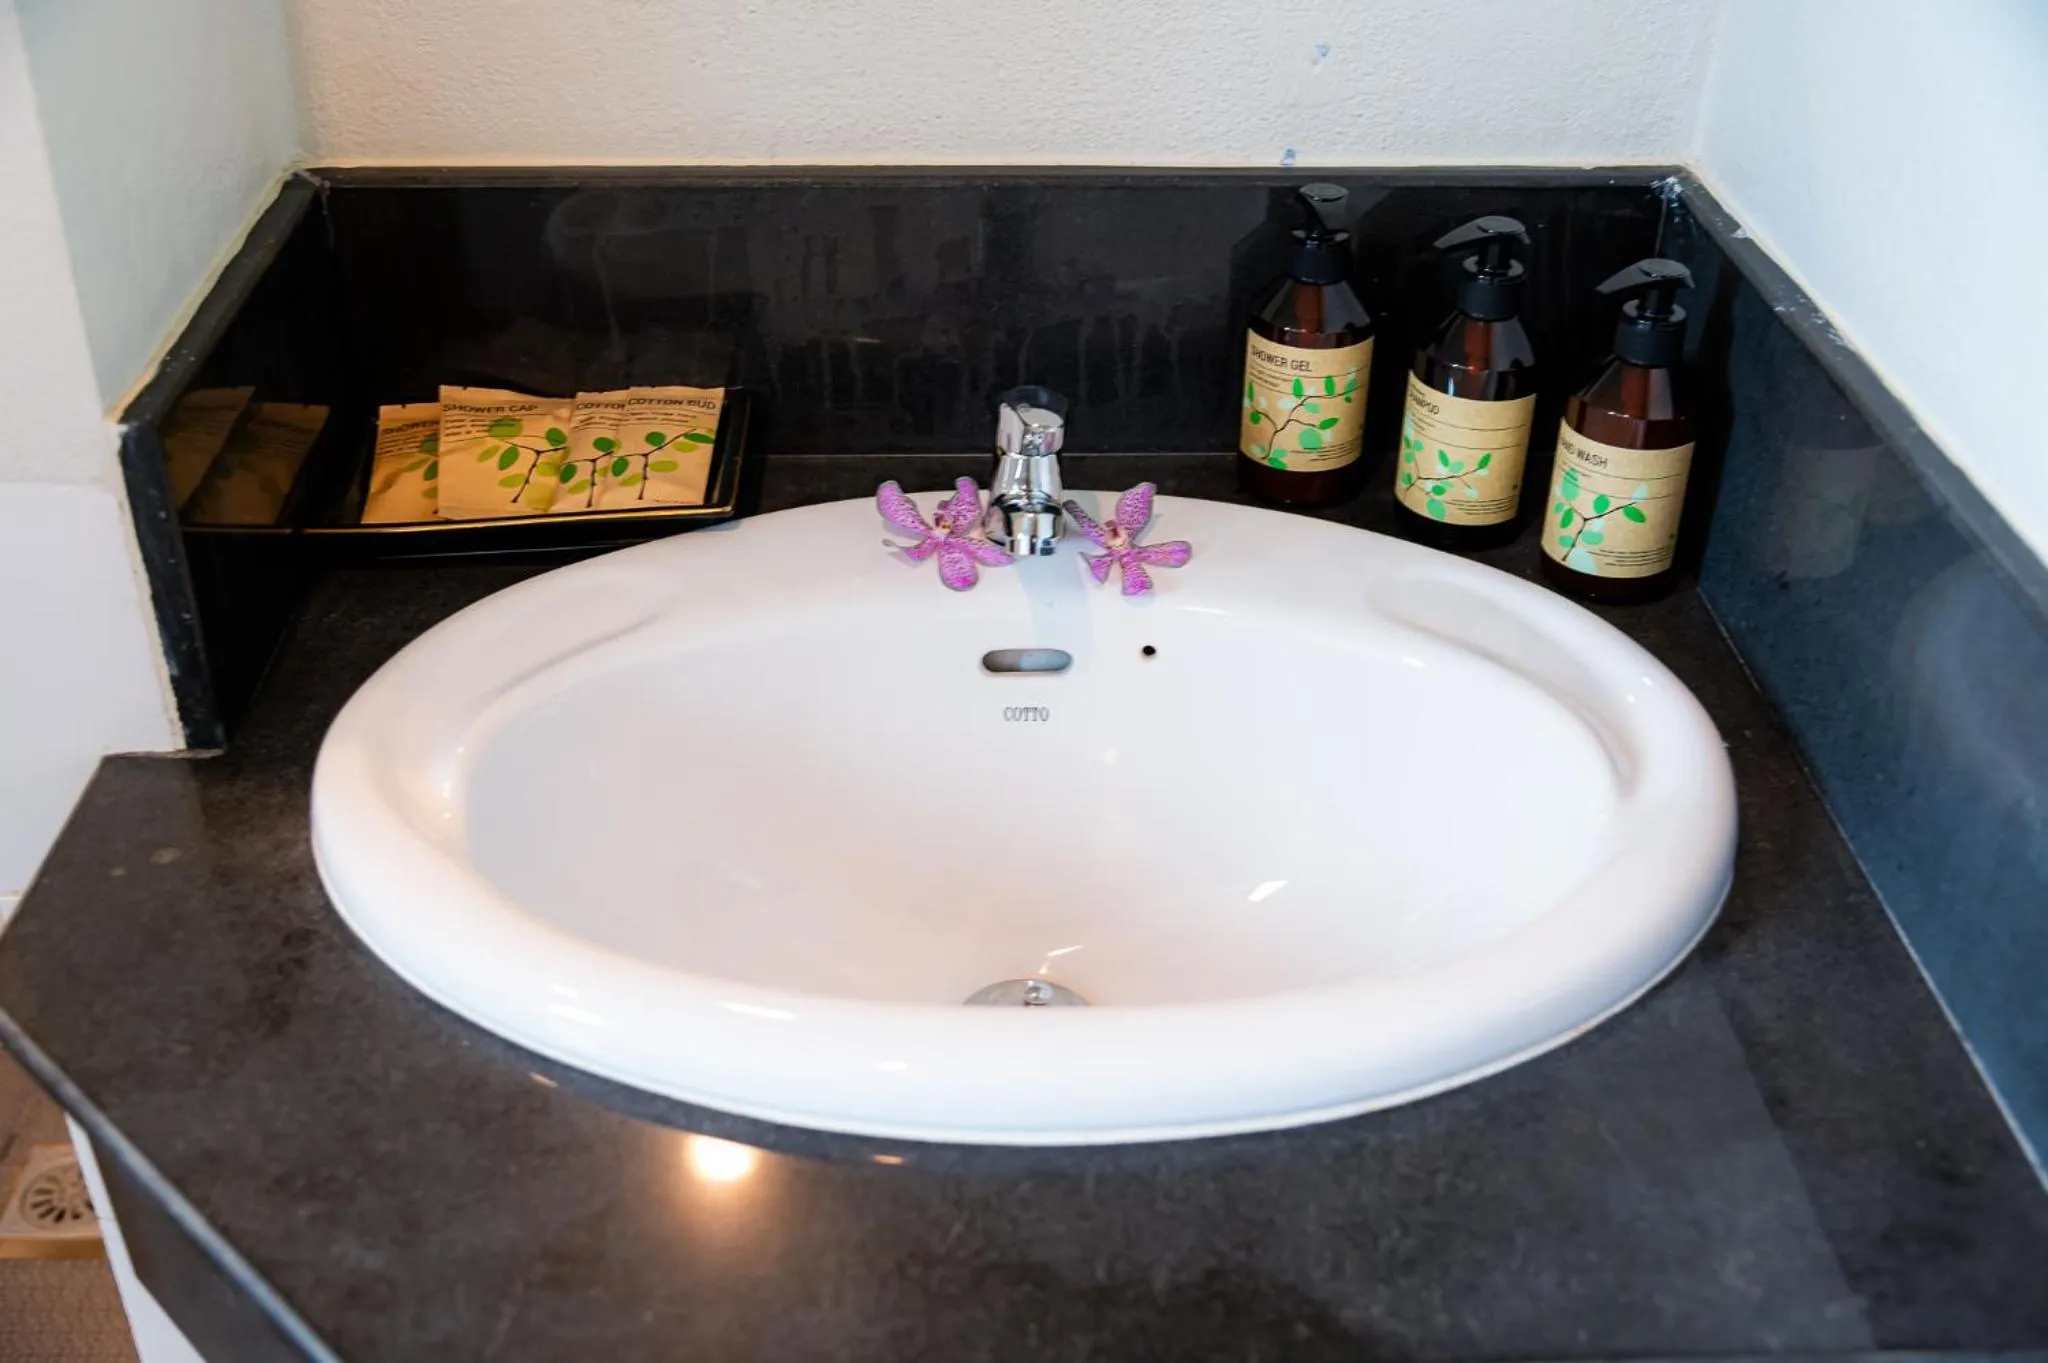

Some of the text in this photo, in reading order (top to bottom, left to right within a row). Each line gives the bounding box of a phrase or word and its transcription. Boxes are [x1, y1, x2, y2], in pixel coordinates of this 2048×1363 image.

[1251, 344, 1312, 372] SHOWER GEL
[442, 403, 538, 413] SHOWER CAP
[687, 399, 717, 410] BUD
[1577, 449, 1608, 469] WASH
[1003, 706, 1049, 722] COTTO
